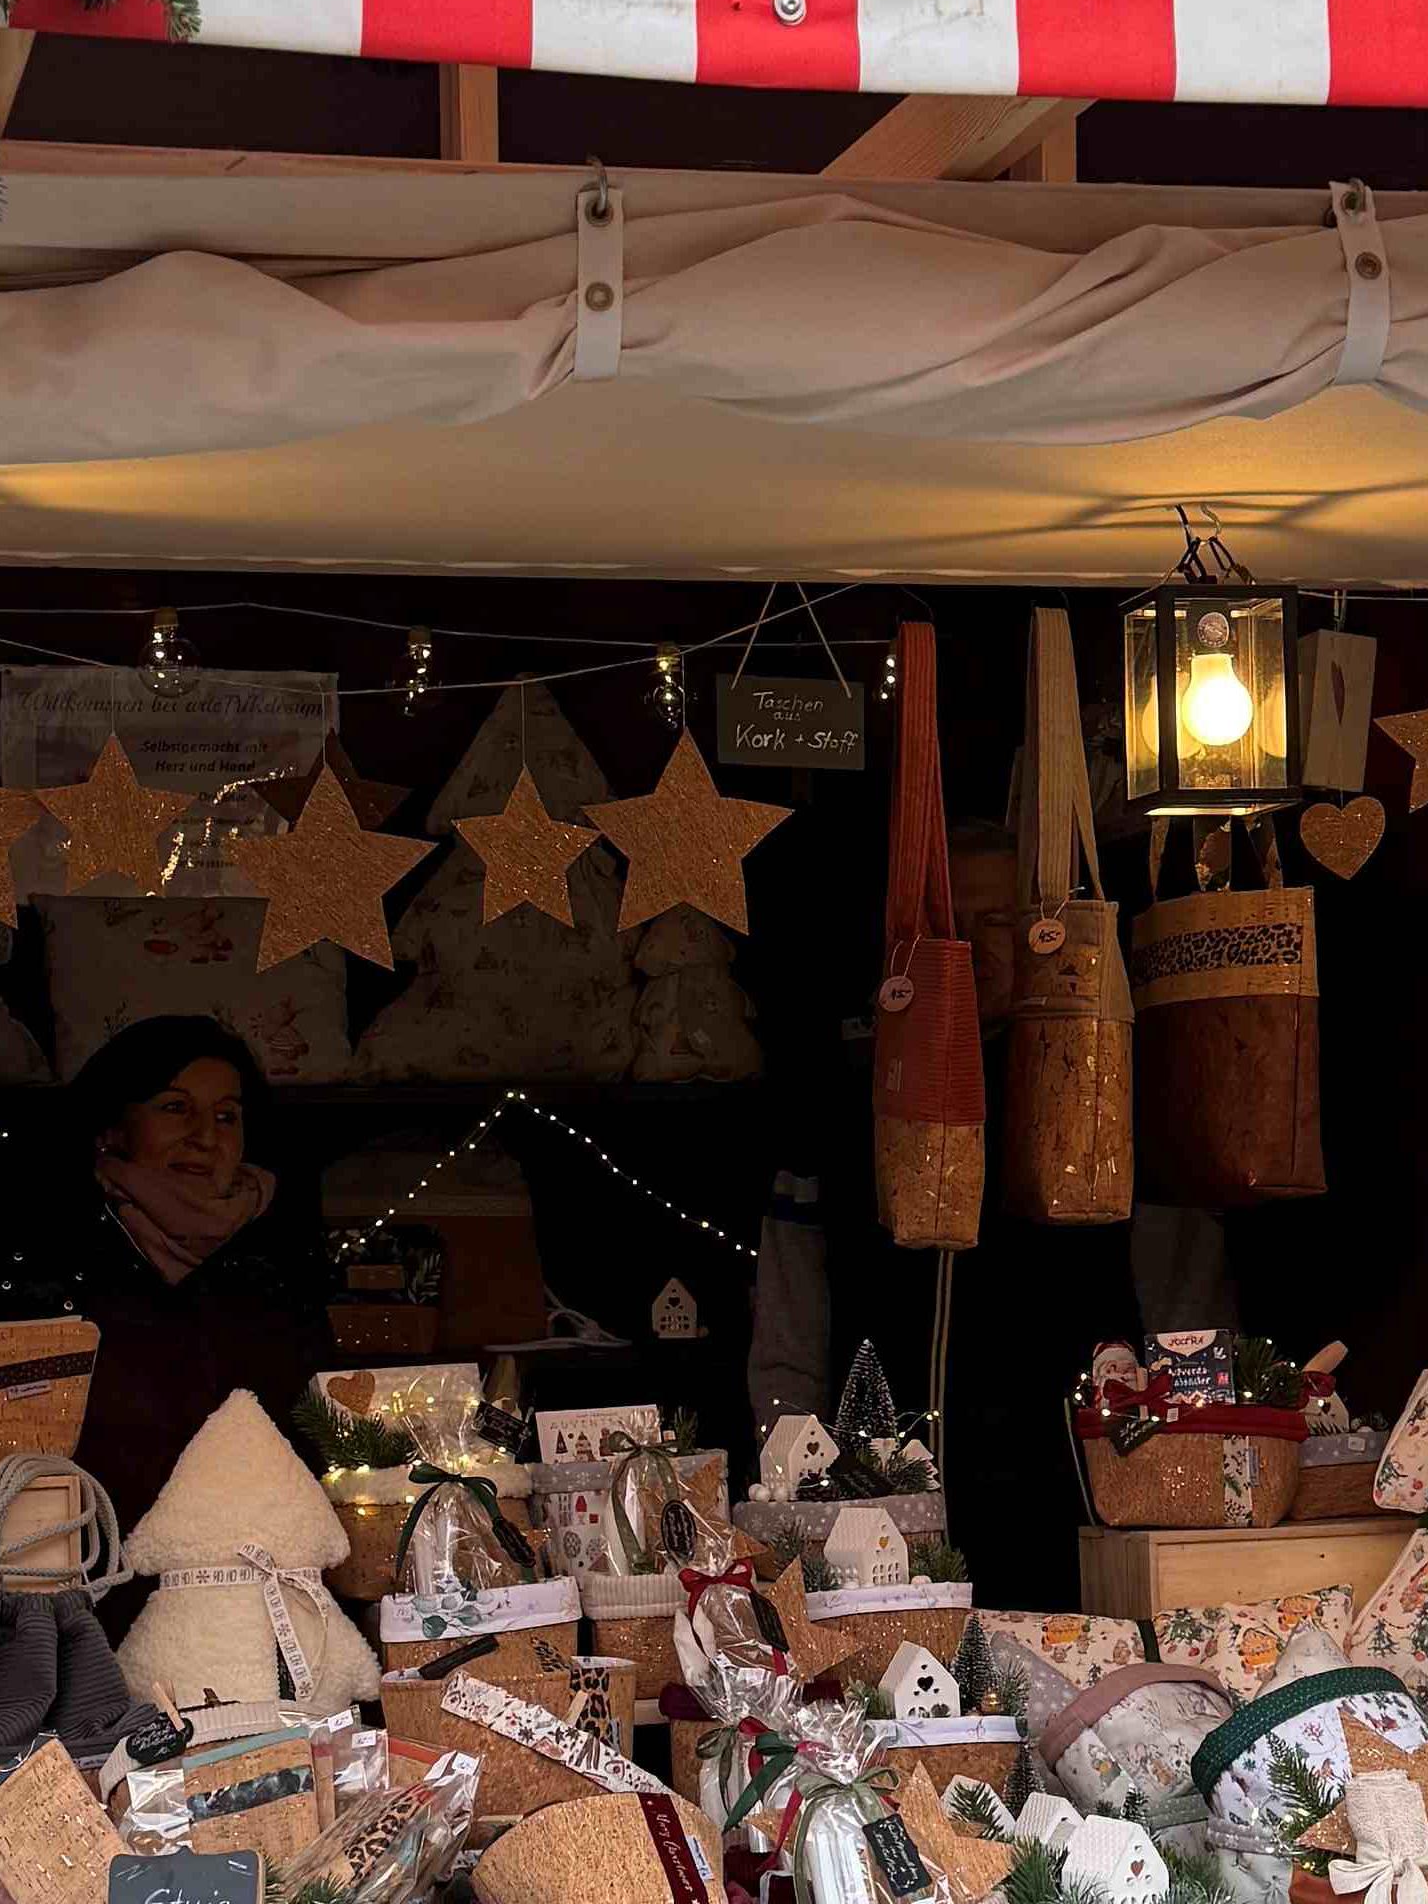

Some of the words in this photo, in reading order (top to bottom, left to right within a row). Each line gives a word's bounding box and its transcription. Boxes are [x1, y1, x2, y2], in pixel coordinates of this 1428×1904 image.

[753, 690, 824, 712] Taschen
[736, 723, 786, 751] Kork
[795, 733, 804, 744] +
[807, 730, 859, 756] Stoff
